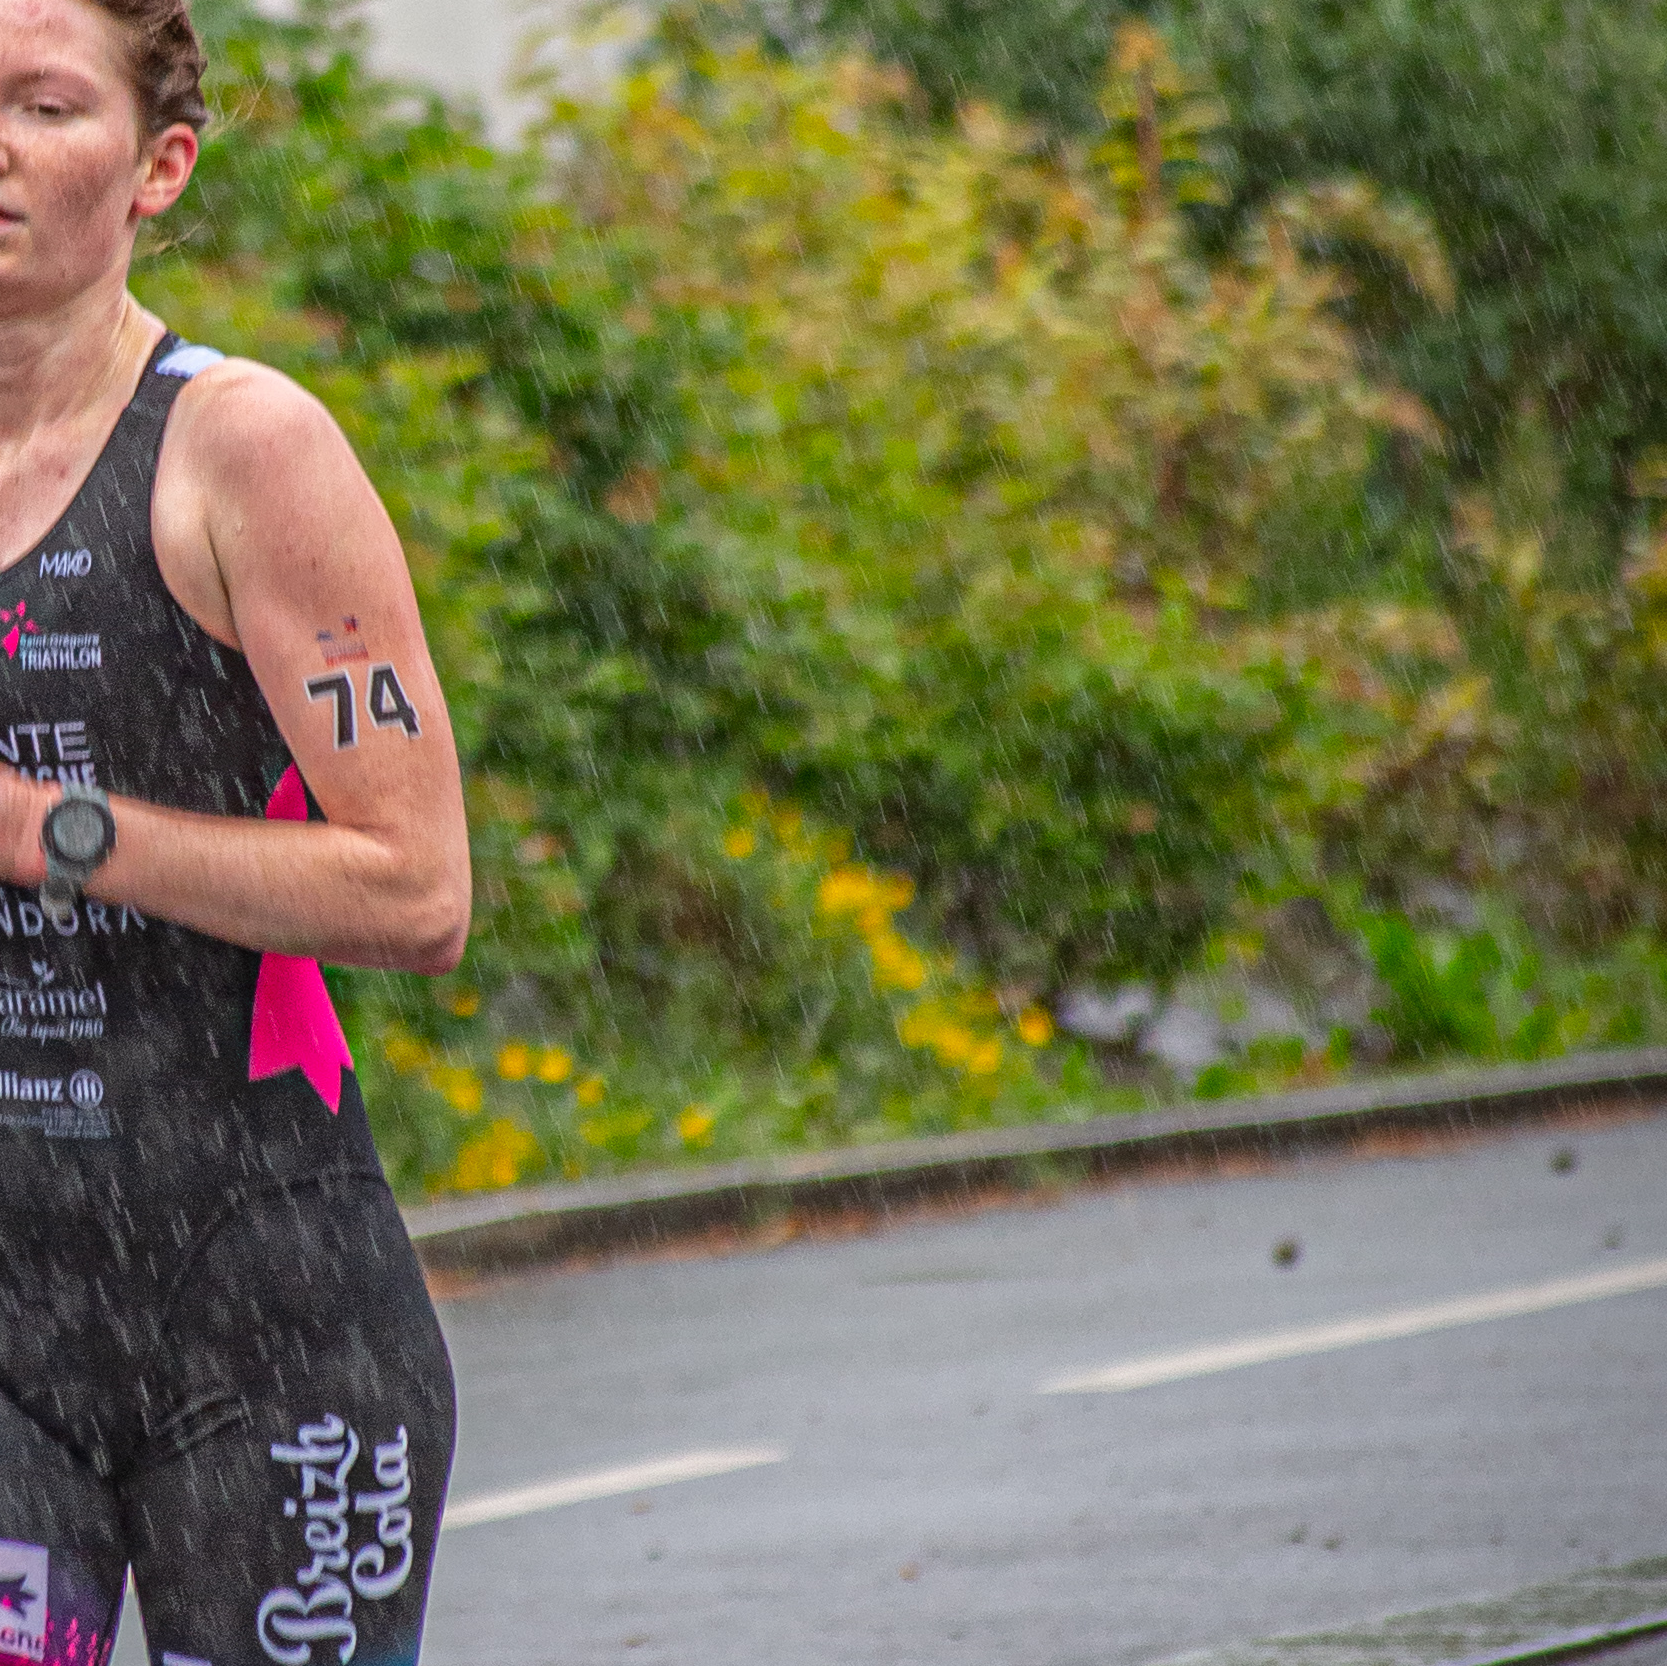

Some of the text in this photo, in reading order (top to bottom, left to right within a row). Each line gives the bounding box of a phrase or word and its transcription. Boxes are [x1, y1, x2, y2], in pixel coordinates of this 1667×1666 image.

[39, 549, 92, 578] MAKO
[20, 647, 102, 671] TRIATHLON
[303, 660, 422, 751] 74
[257, 1413, 360, 1666] Breizh
[351, 1424, 414, 1600] Cola
